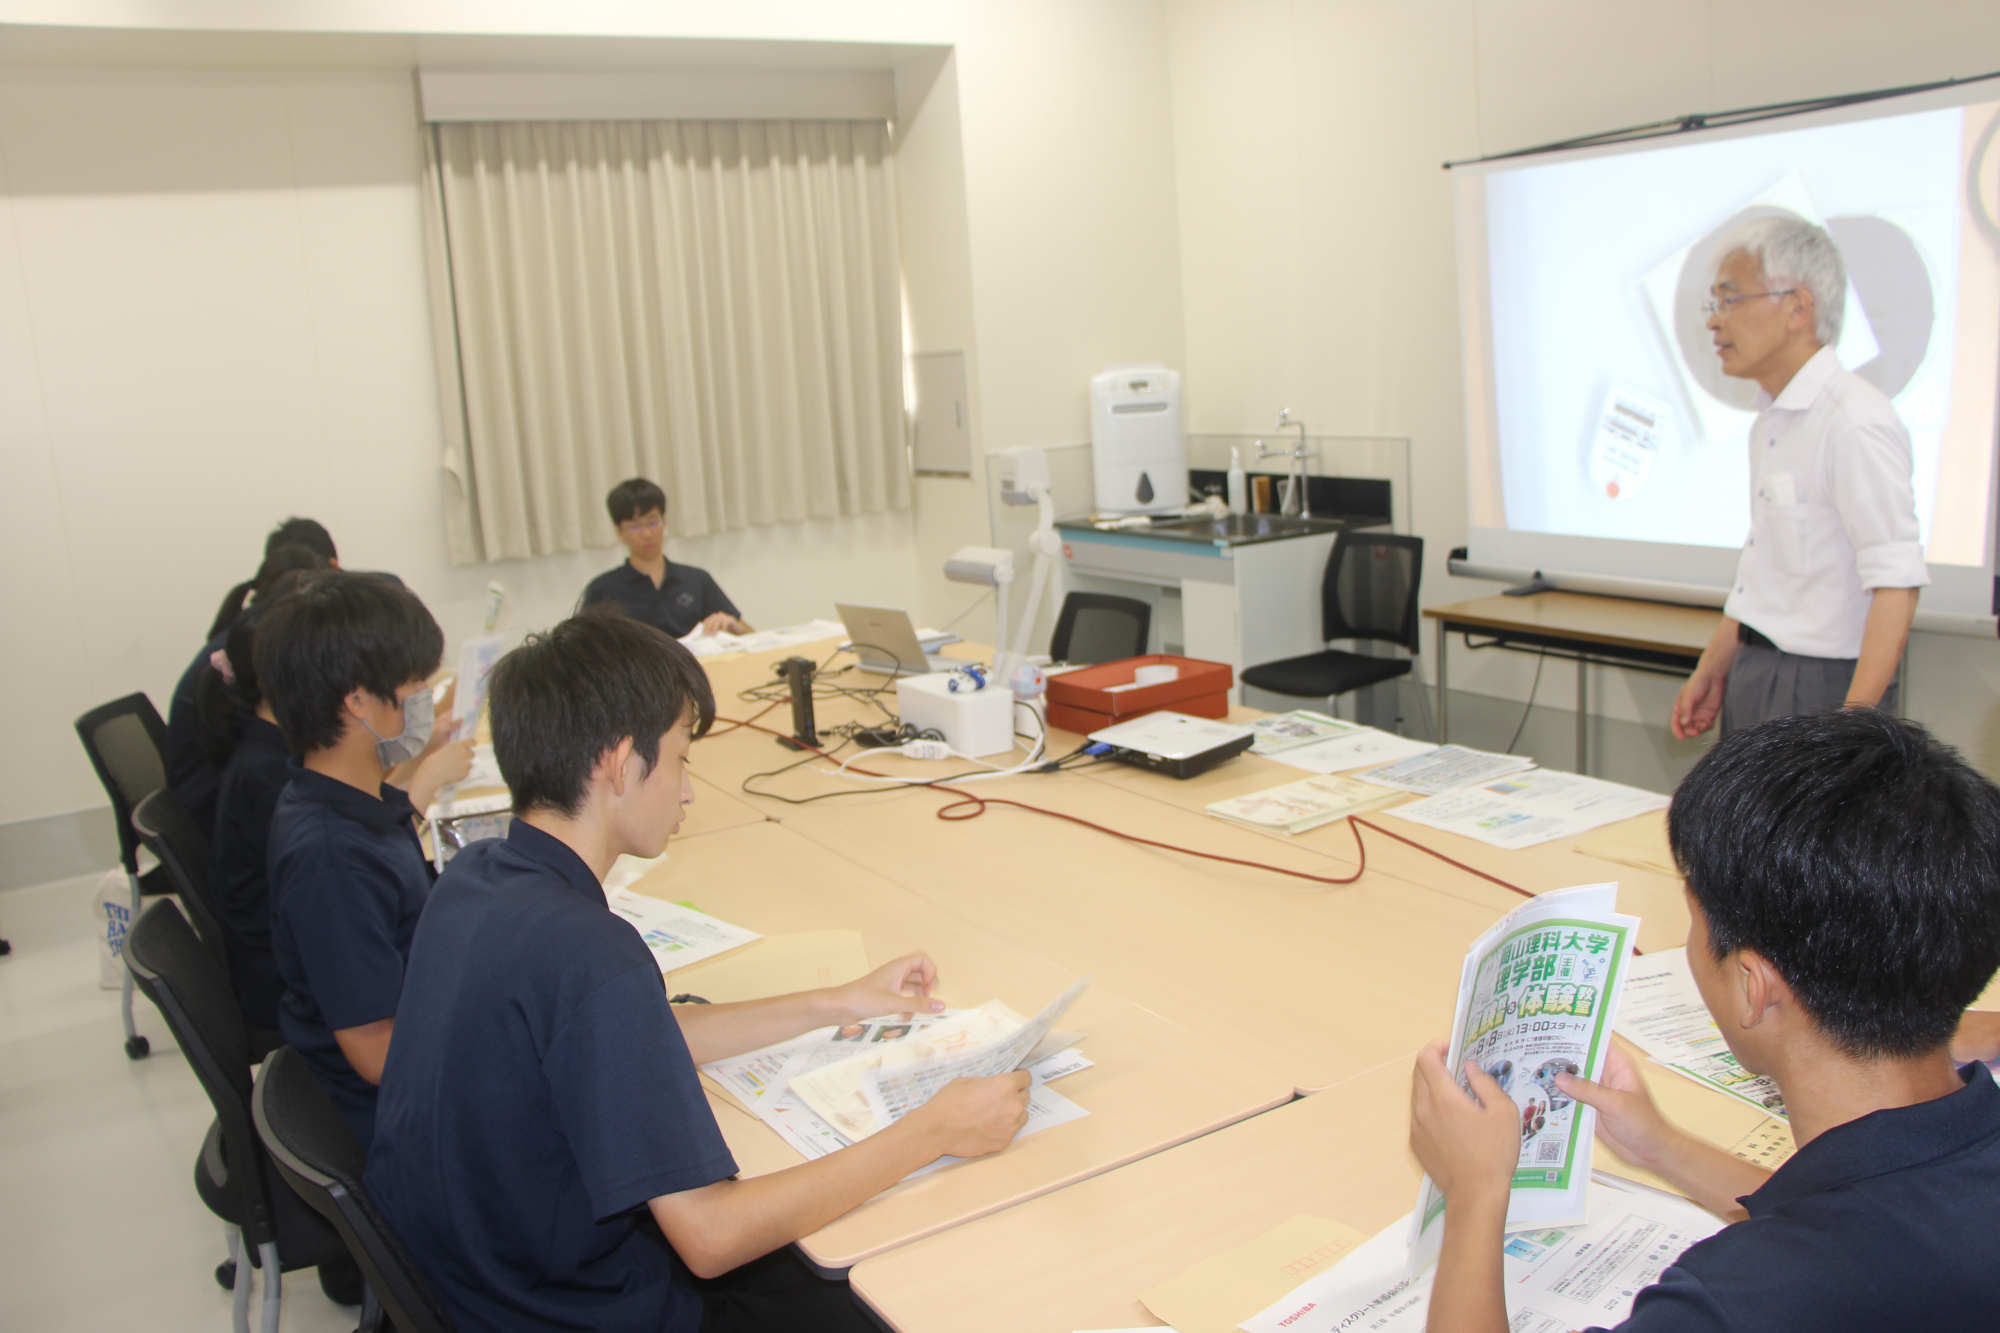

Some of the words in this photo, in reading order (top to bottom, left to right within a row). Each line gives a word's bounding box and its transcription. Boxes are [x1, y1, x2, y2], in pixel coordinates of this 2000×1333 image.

[1500, 930, 1610, 965] 岡山理科大学
[1493, 954, 1558, 995] 理学部
[1517, 982, 1598, 1020] 体験教室
[1277, 1302, 1317, 1328] TOSHIBA
